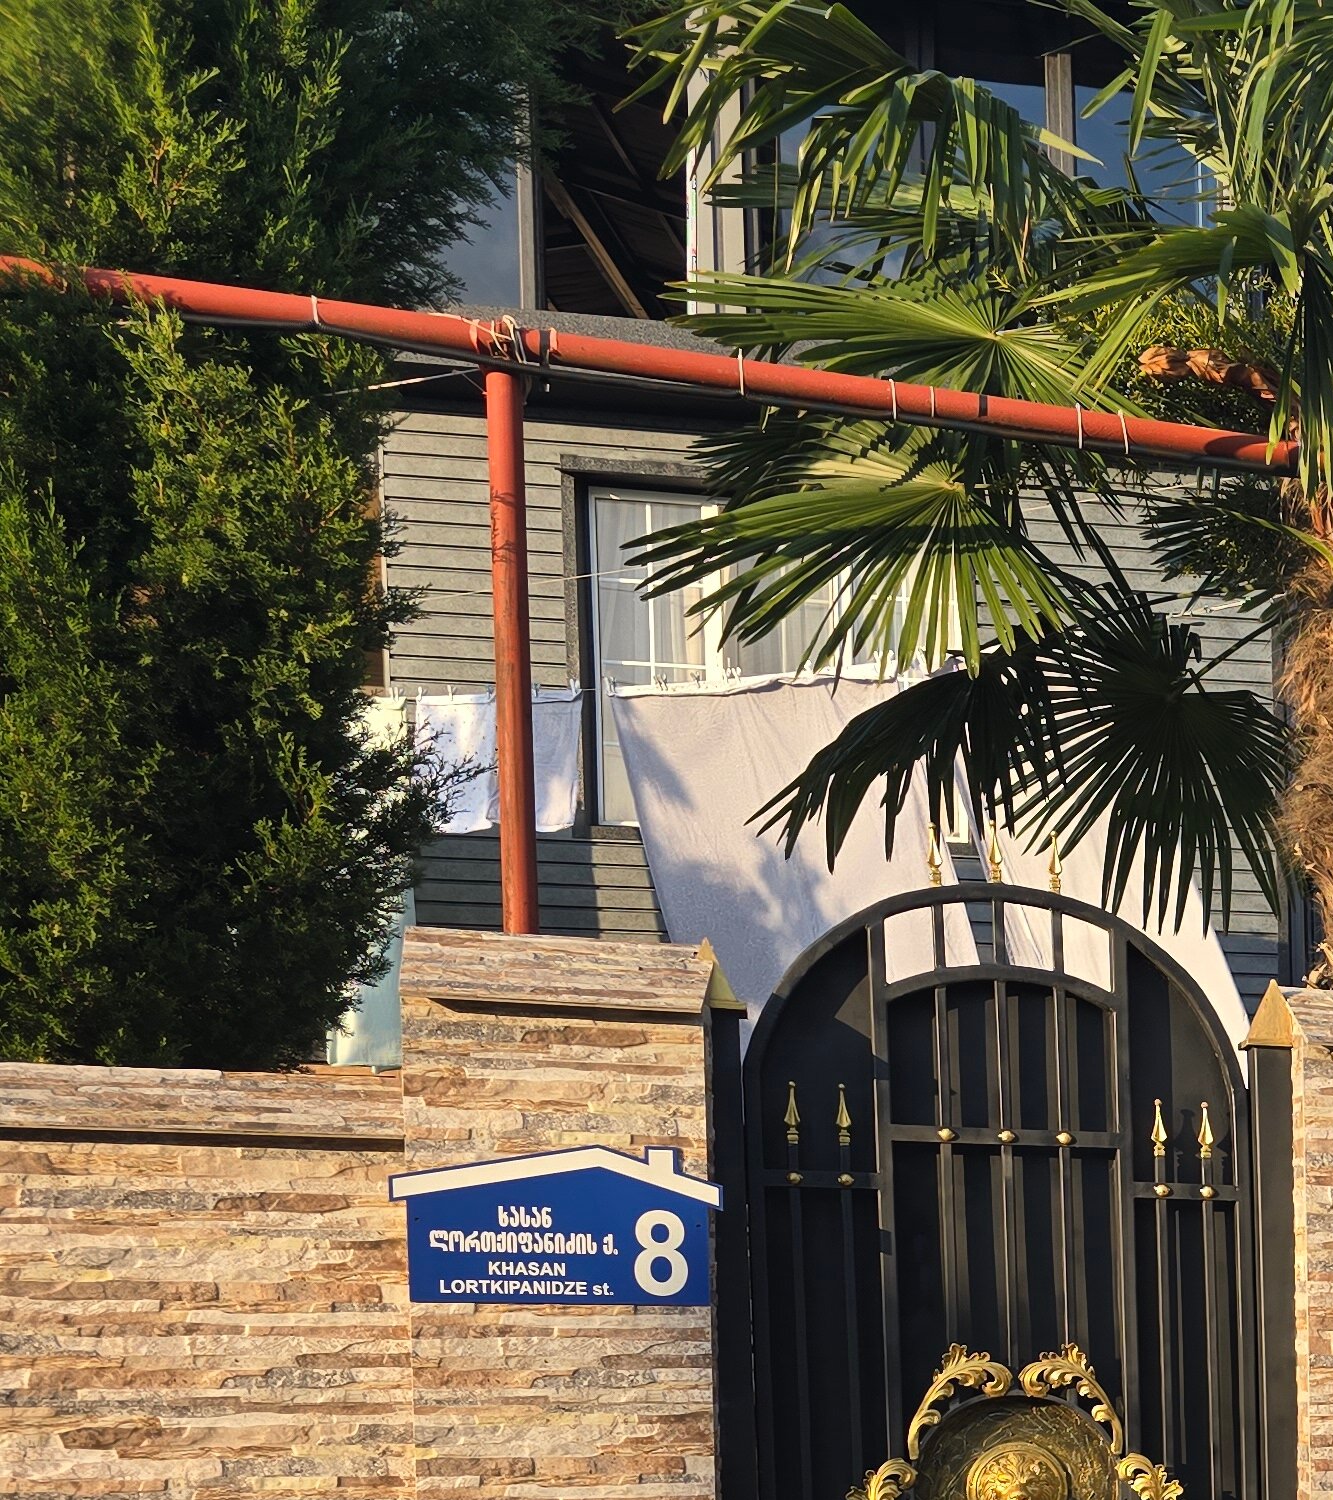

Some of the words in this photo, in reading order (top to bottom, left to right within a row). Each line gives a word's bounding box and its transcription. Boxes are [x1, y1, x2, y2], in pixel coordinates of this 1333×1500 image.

[634, 1209, 689, 1296] 8
[488, 1261, 567, 1277] KHASAN
[439, 1279, 588, 1296] LORTKIPANIDZE
[592, 1282, 615, 1296] st.
